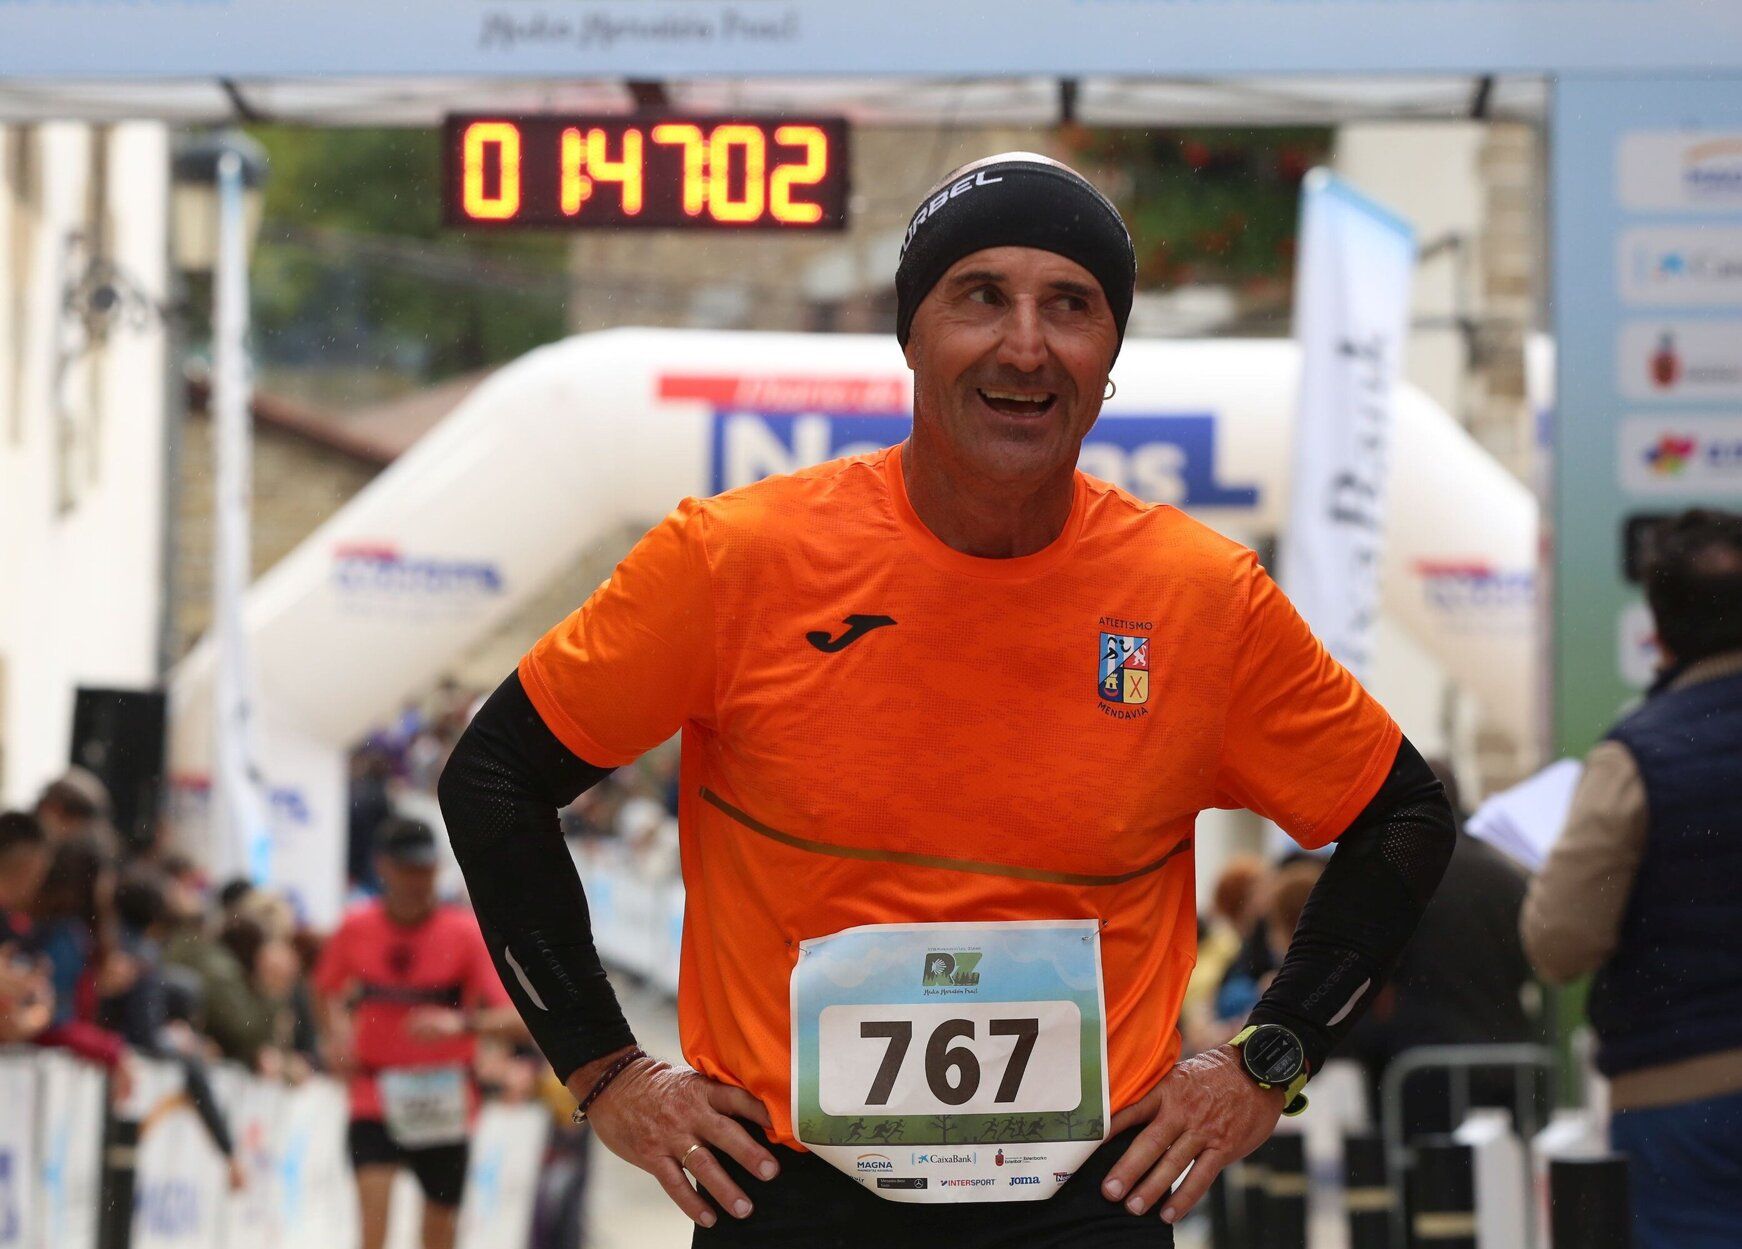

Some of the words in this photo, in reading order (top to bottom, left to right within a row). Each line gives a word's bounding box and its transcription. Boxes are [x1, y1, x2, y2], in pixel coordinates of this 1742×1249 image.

[1098, 617, 1153, 631] ATLETISMO
[1097, 701, 1149, 720] MENDAVIA
[860, 1017, 1039, 1106] 767
[857, 1161, 893, 1169] MAGNA
[930, 1154, 972, 1165] CaixaBank
[948, 1178, 996, 1186] INTERSPORT
